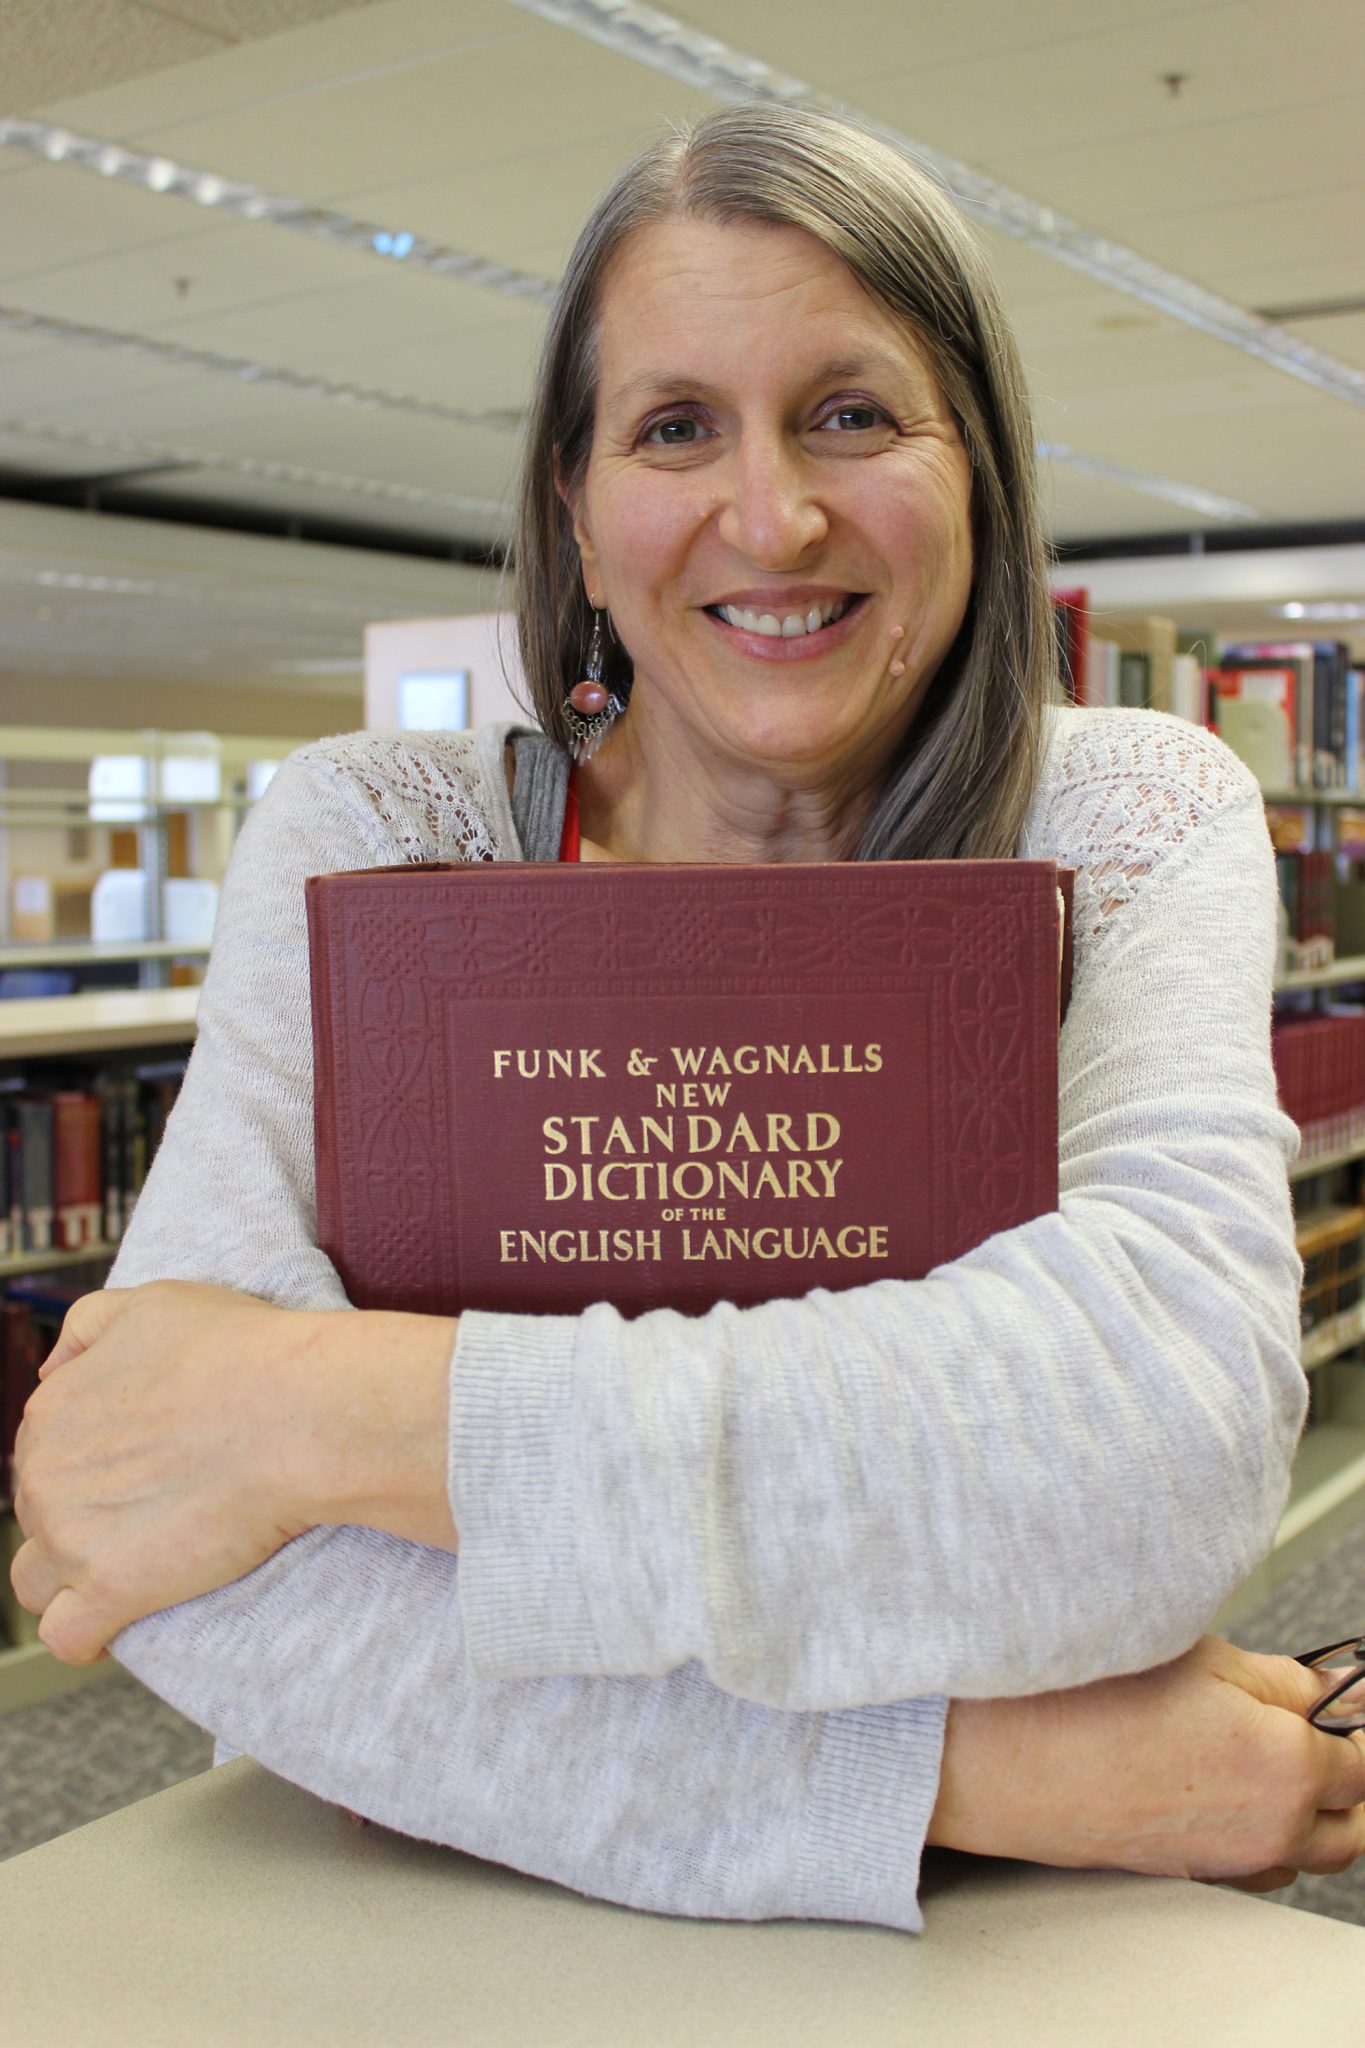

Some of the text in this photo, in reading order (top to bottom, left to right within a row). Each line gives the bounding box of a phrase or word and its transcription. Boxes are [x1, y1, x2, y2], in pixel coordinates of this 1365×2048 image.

[493, 1043, 883, 1079] FUNK & WAGNALLS
[655, 1082, 732, 1108] NEW
[542, 1112, 841, 1155] STANDARD
[543, 1158, 843, 1201] DICTIONARY
[661, 1207, 726, 1222] OF THE
[499, 1225, 889, 1263] ENGLISH LANGUAGE
